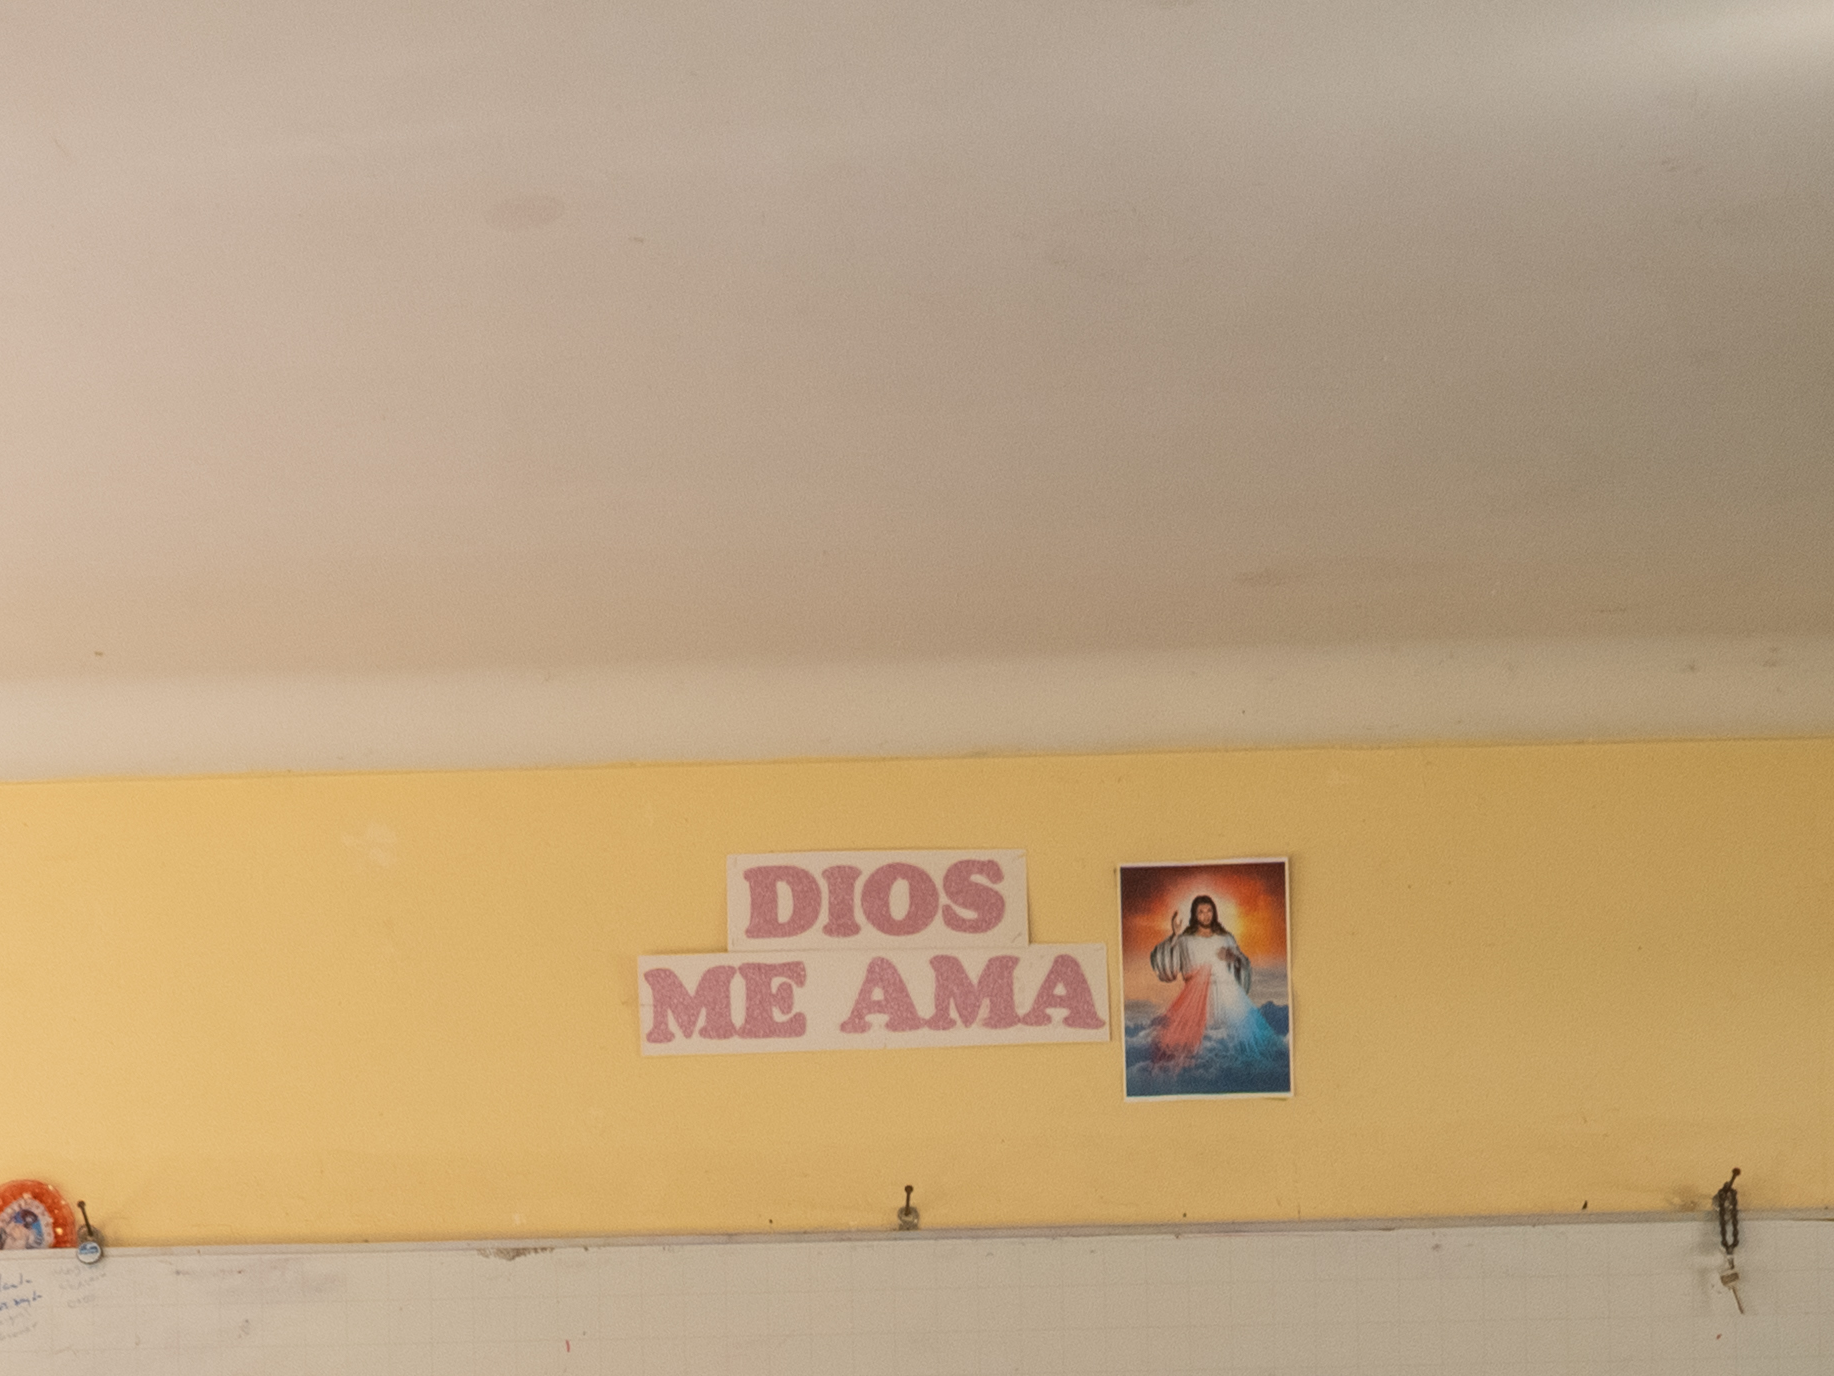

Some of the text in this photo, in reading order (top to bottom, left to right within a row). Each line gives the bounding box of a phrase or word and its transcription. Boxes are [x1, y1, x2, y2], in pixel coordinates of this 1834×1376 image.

[744, 859, 1006, 940] DIOS
[643, 953, 1106, 1044] ME AMA
